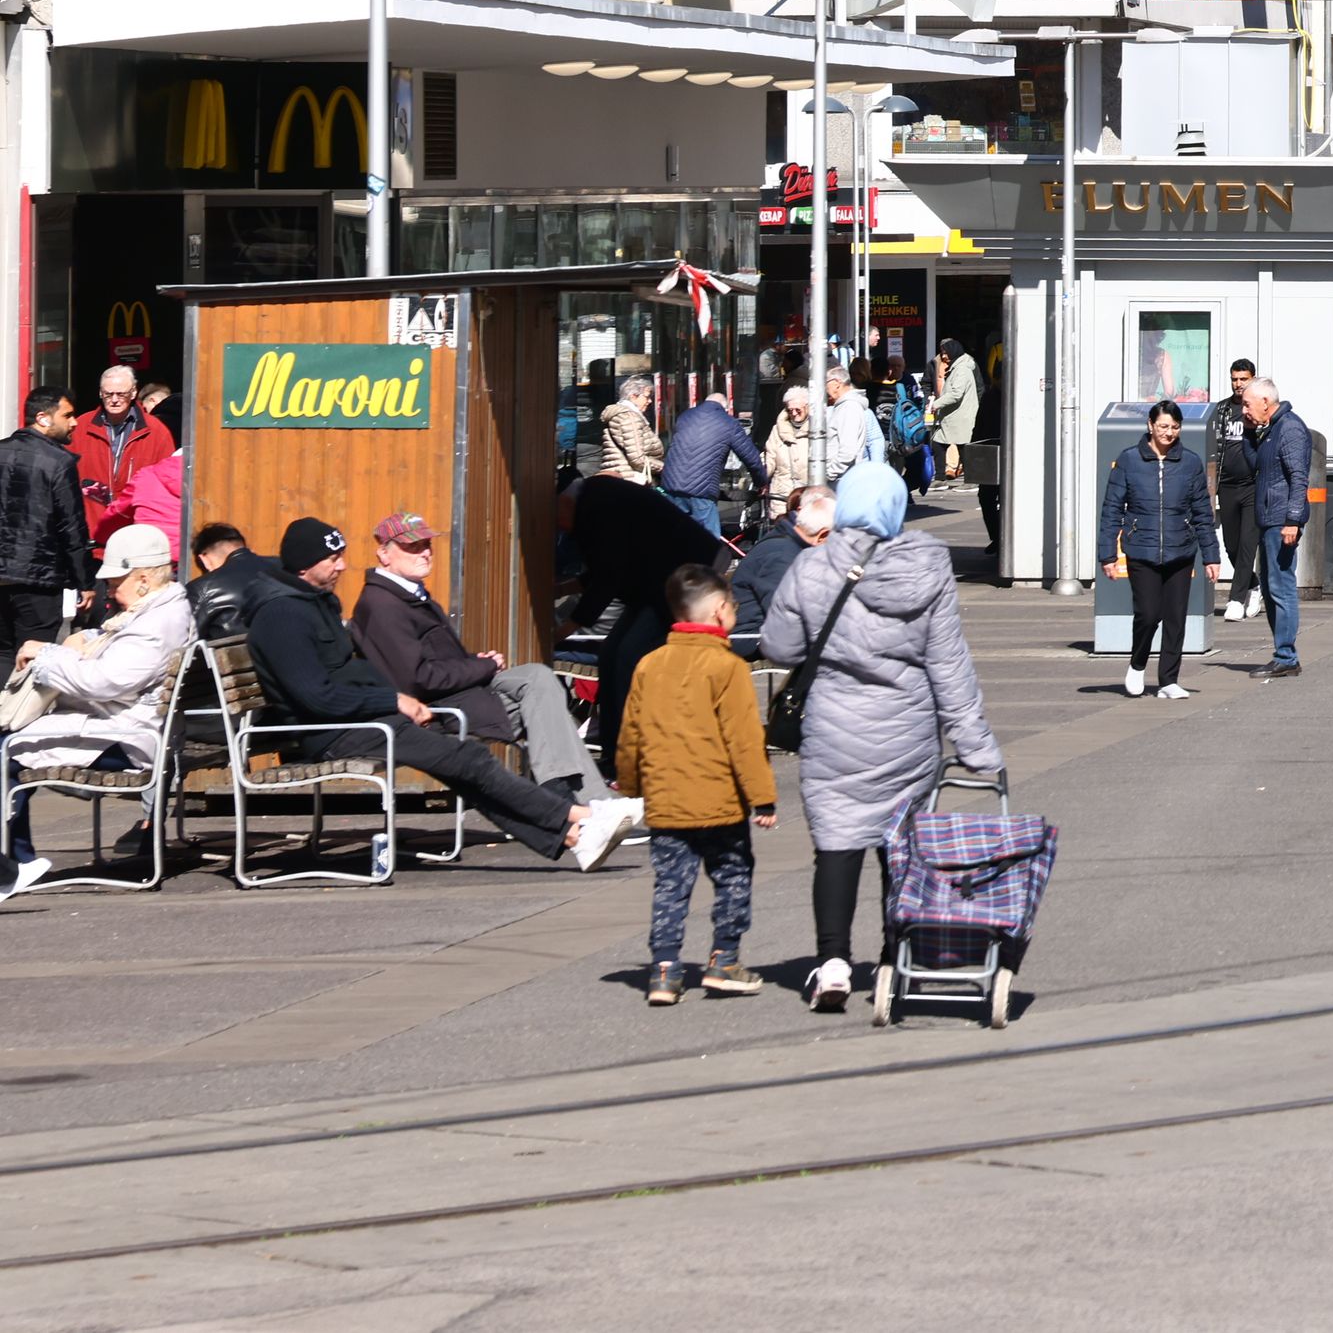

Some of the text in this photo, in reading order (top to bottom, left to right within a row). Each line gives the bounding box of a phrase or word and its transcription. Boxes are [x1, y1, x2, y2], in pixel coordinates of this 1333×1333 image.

[1041, 181, 1294, 214] BLUMEN
[837, 209, 864, 221] FALAL
[229, 351, 423, 418] Maroni
